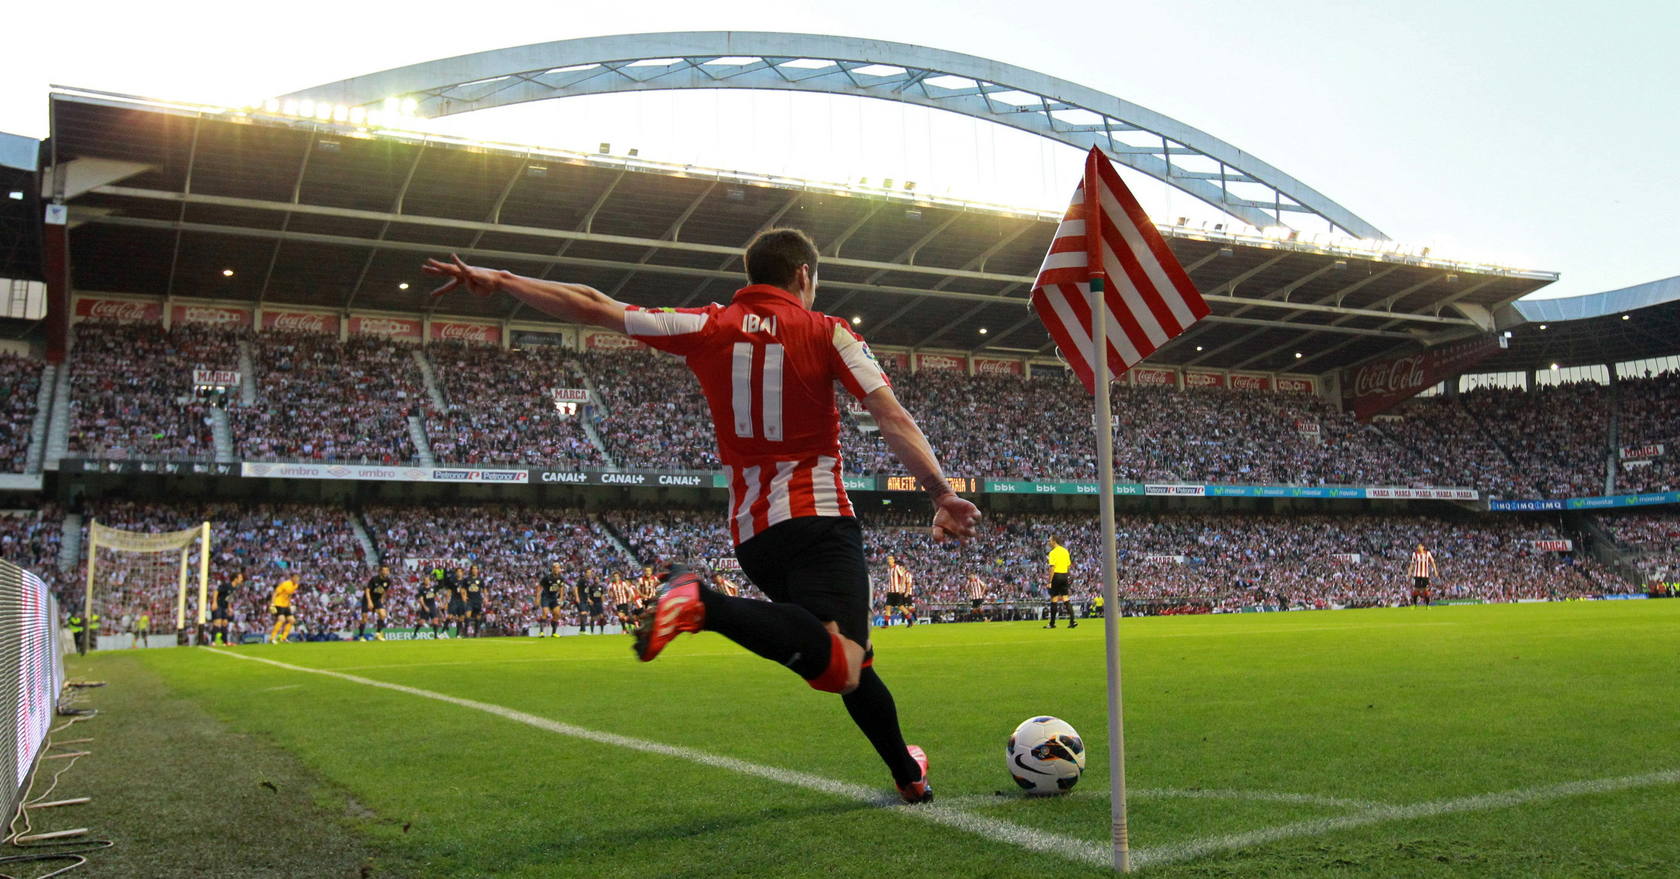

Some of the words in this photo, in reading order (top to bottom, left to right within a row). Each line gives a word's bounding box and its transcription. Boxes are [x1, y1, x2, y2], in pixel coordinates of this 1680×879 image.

[742, 313, 777, 336] IBAI
[197, 371, 236, 384] MARCA
[554, 390, 587, 400] MARCA
[732, 342, 784, 441] 11
[280, 466, 319, 476] umbro
[358, 467, 396, 478] umbro
[435, 471, 466, 480] Petronor
[483, 472, 513, 480] Petronor
[541, 472, 587, 482] CANAL+
[601, 473, 645, 484] CANAL+
[659, 475, 701, 485] CANAL+
[887, 477, 916, 491] ATHLETIC
[994, 483, 1015, 492] bbk
[1036, 484, 1056, 493] bbk
[1077, 485, 1097, 493] bbk
[1116, 486, 1136, 494] bbk
[1496, 502, 1511, 510] IMQ
[1517, 502, 1535, 510] IMQ
[1541, 501, 1561, 510] IMQ
[1535, 541, 1568, 551] MARCA
[712, 559, 742, 569] MARC
